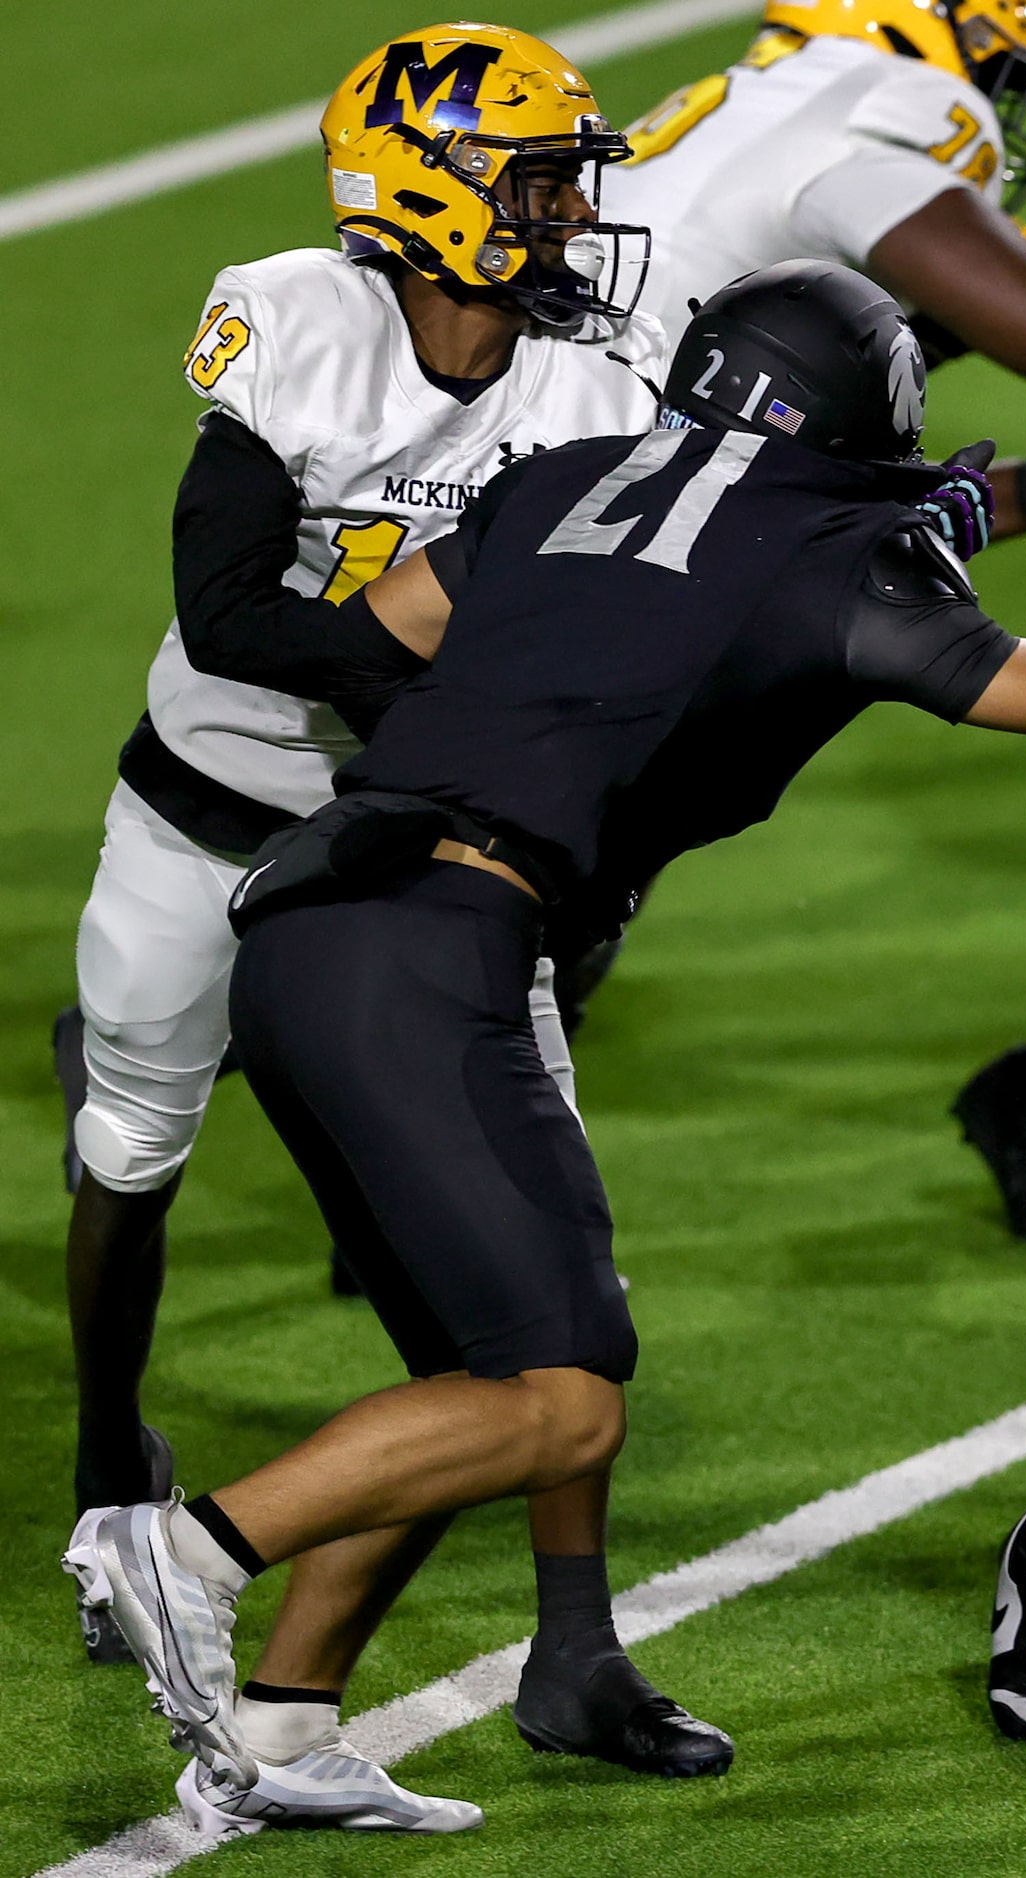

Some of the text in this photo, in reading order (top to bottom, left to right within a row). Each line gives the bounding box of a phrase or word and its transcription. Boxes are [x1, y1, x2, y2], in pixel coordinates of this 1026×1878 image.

[365, 42, 504, 131] M
[183, 301, 251, 391] 13
[691, 349, 772, 422] 21
[536, 429, 768, 575] 21
[320, 516, 410, 608] 1
